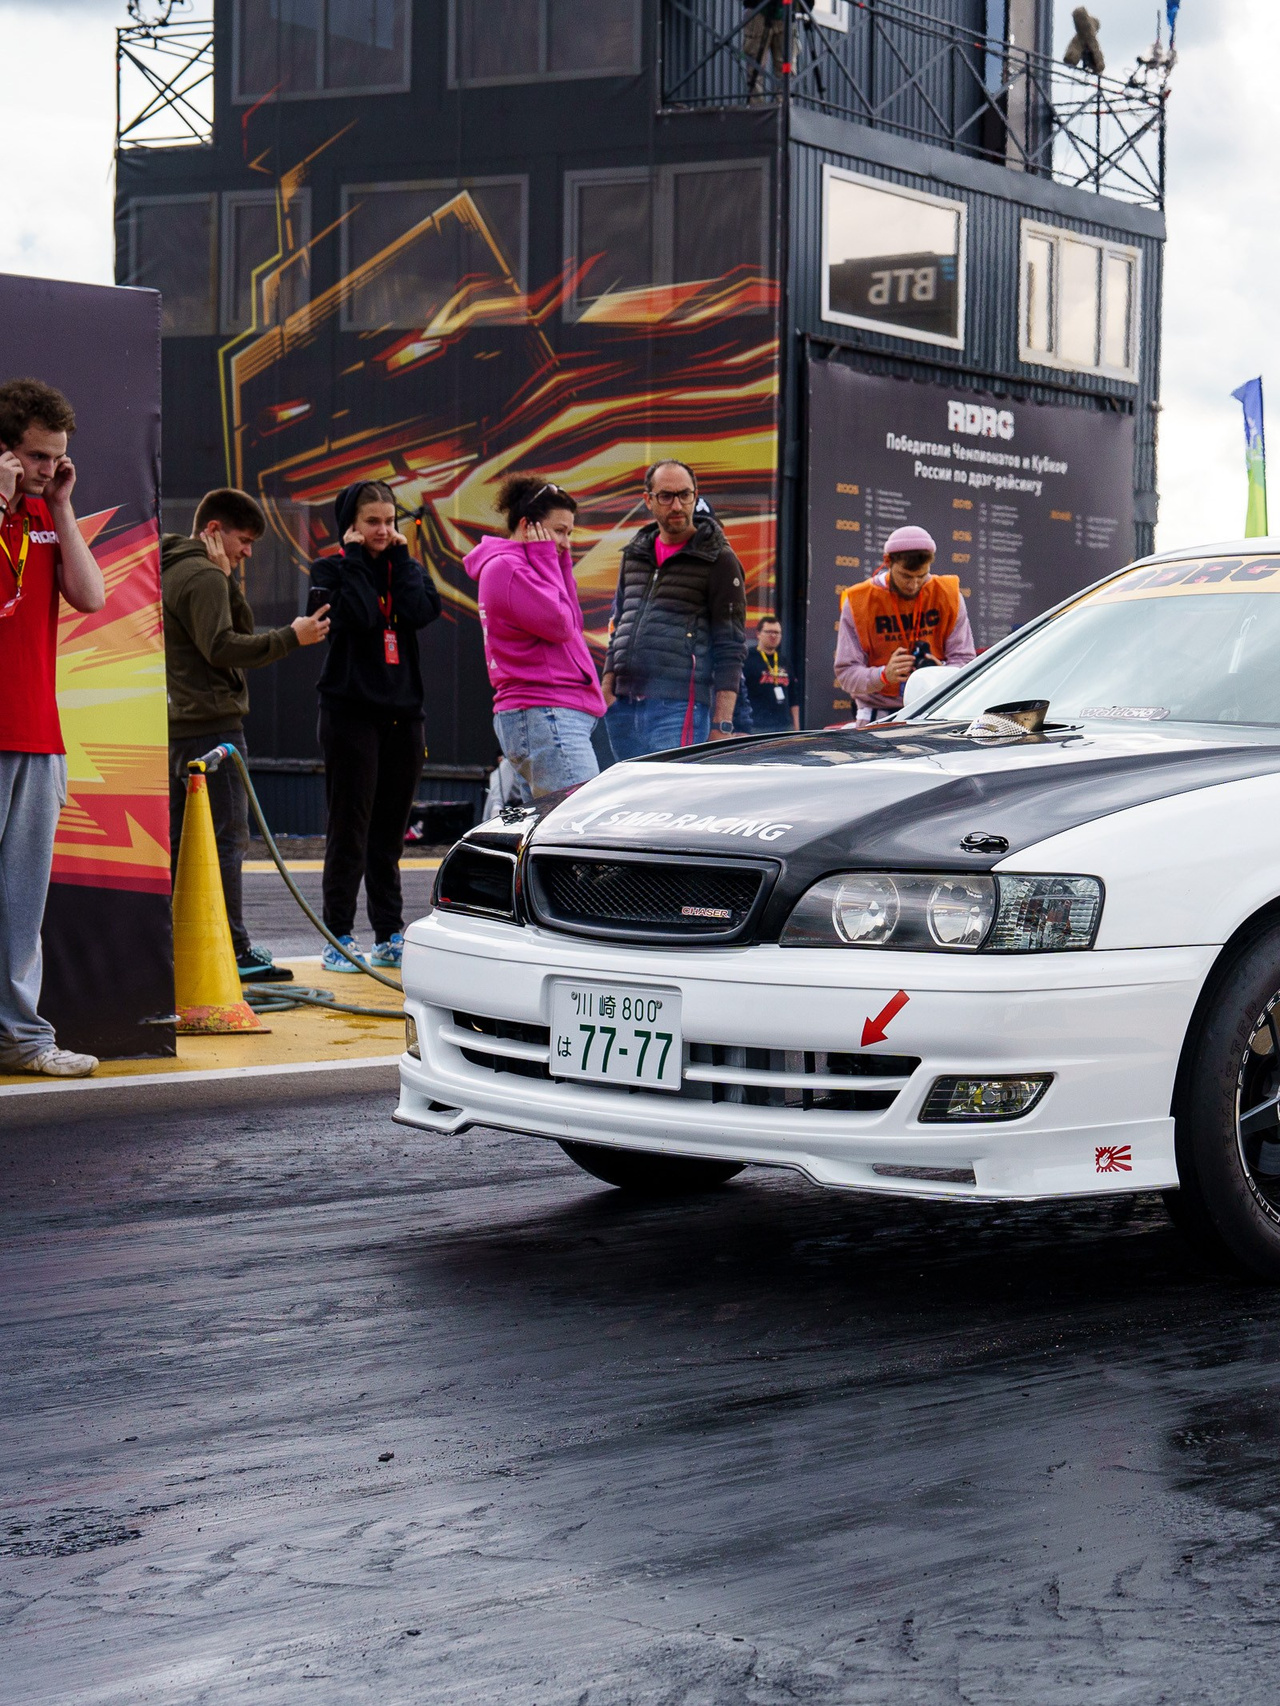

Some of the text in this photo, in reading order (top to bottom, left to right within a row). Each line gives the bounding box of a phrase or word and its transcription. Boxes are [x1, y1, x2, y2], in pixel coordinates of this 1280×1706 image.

[947, 400, 1016, 441] RDRC
[885, 432, 1069, 475] Победители Чемпионатов и Кубков
[914, 459, 1043, 497] России по дрэг-рейсингу
[29, 530, 61, 544] RDR
[598, 810, 795, 842] SMP RACING
[681, 905, 731, 919] CHASER
[575, 992, 657, 1023] 川崎 800
[557, 1023, 673, 1081] は 77-77
